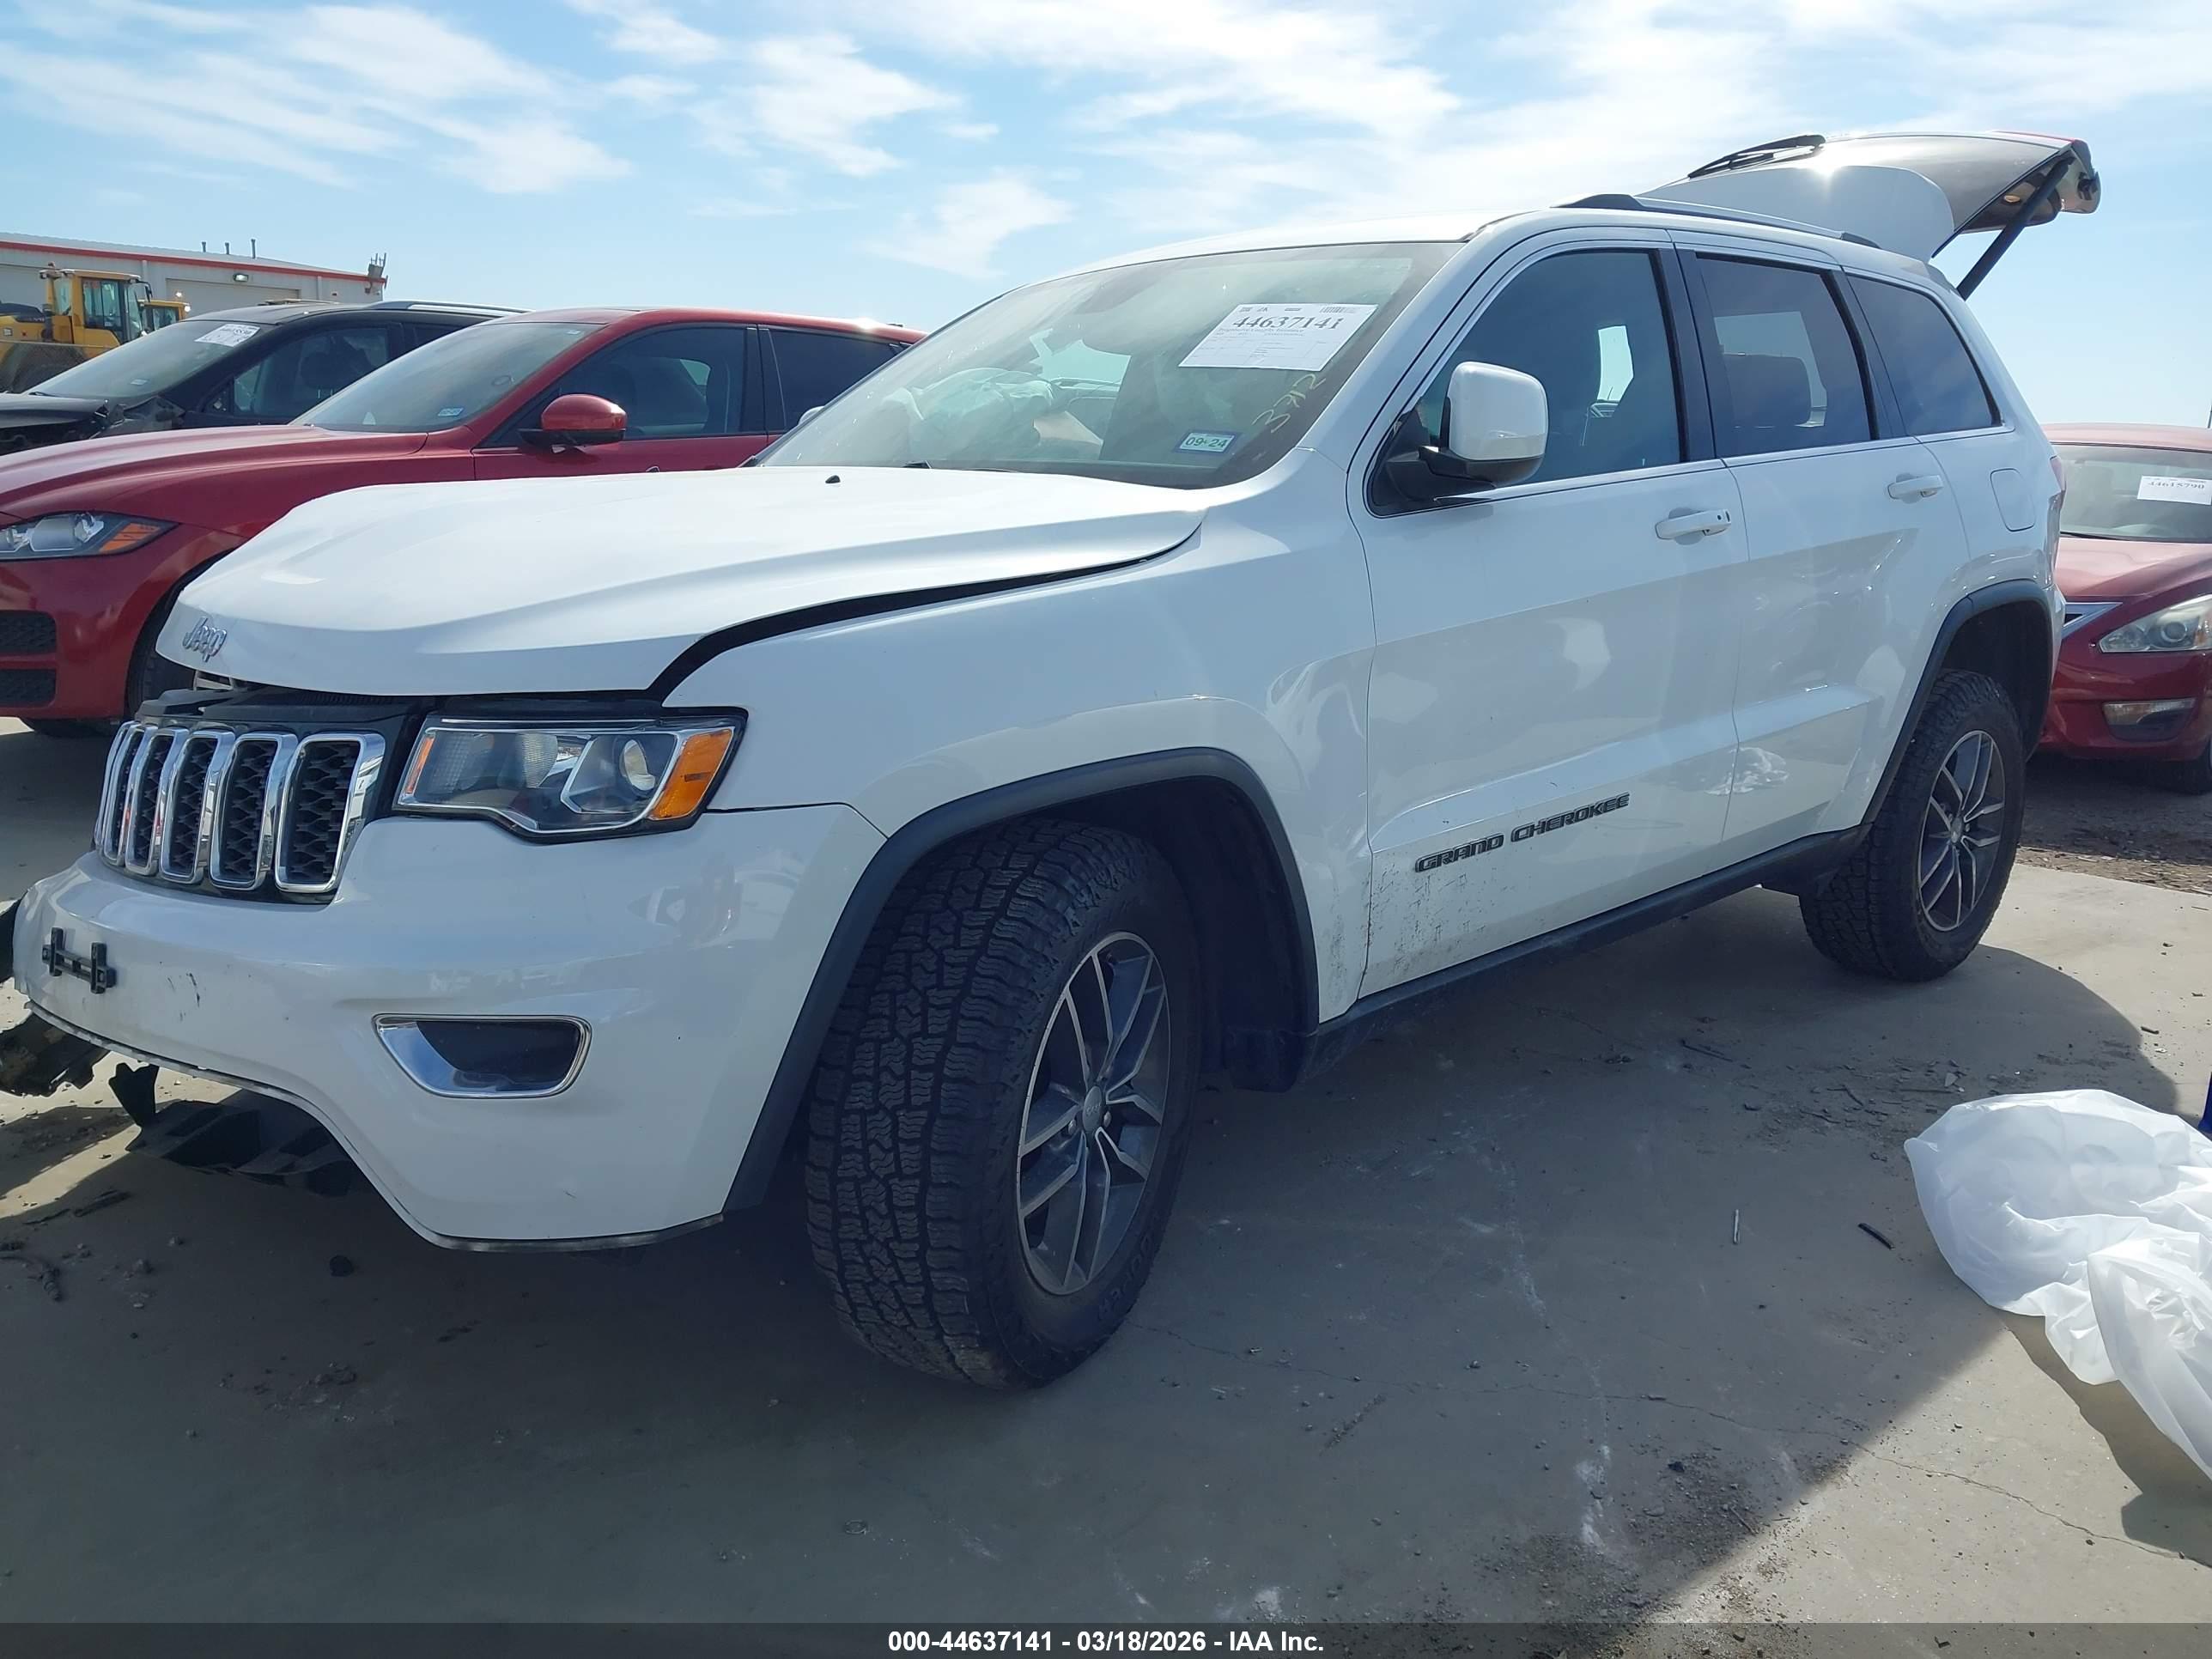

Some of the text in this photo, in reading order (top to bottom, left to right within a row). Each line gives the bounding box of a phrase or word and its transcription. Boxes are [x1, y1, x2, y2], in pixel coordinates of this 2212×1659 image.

[1233, 316, 1344, 330] 44637141
[182, 616, 228, 663] Jeep
[1415, 792, 1630, 873] GRAND CHEROKEE
